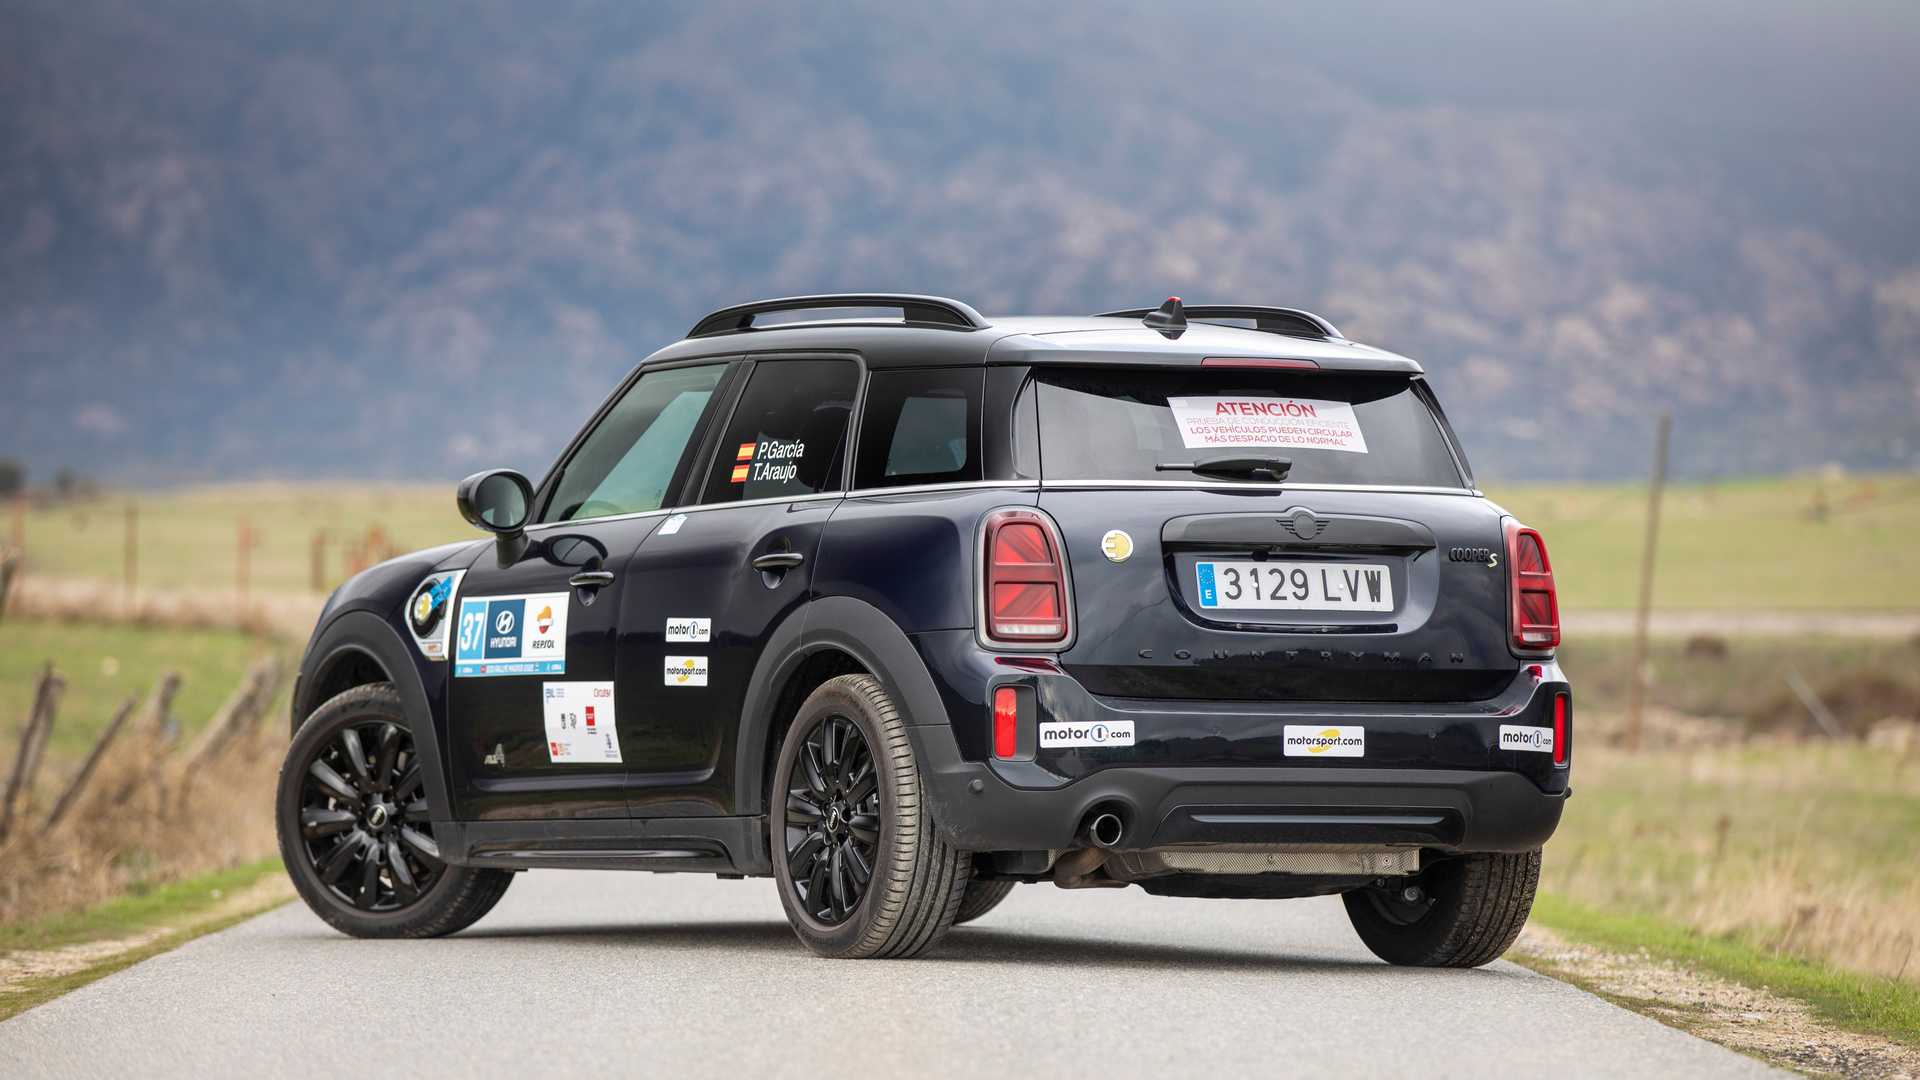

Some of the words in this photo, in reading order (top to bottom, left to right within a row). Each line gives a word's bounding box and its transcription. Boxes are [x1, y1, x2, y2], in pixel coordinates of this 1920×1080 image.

[1215, 400, 1318, 417] ATENCIÓN
[1190, 426, 1211, 435] LOS
[1212, 425, 1268, 434] VEHÍCULOS
[1269, 426, 1307, 435] PUEDEN
[1307, 428, 1353, 438] CIRCULAR
[1229, 434, 1278, 443] DESPACIO
[1279, 435, 1292, 443] DE
[1292, 436, 1305, 444] LO
[1306, 436, 1347, 446] NORMAL
[757, 439, 805, 460] P.García
[753, 461, 798, 484] T.Araujo
[1449, 547, 1490, 562] COOPER
[1205, 589, 1212, 600] E
[1223, 567, 1310, 601] 3129
[1321, 568, 1382, 602] LVW
[460, 612, 485, 651] 37
[490, 636, 518, 648] HYUNDAI
[532, 639, 555, 649] REPSOL
[1138, 649, 1464, 665] COUNTRYMAN
[666, 667, 707, 677] motorsport.com
[1287, 736, 1363, 748] motorsport.com
